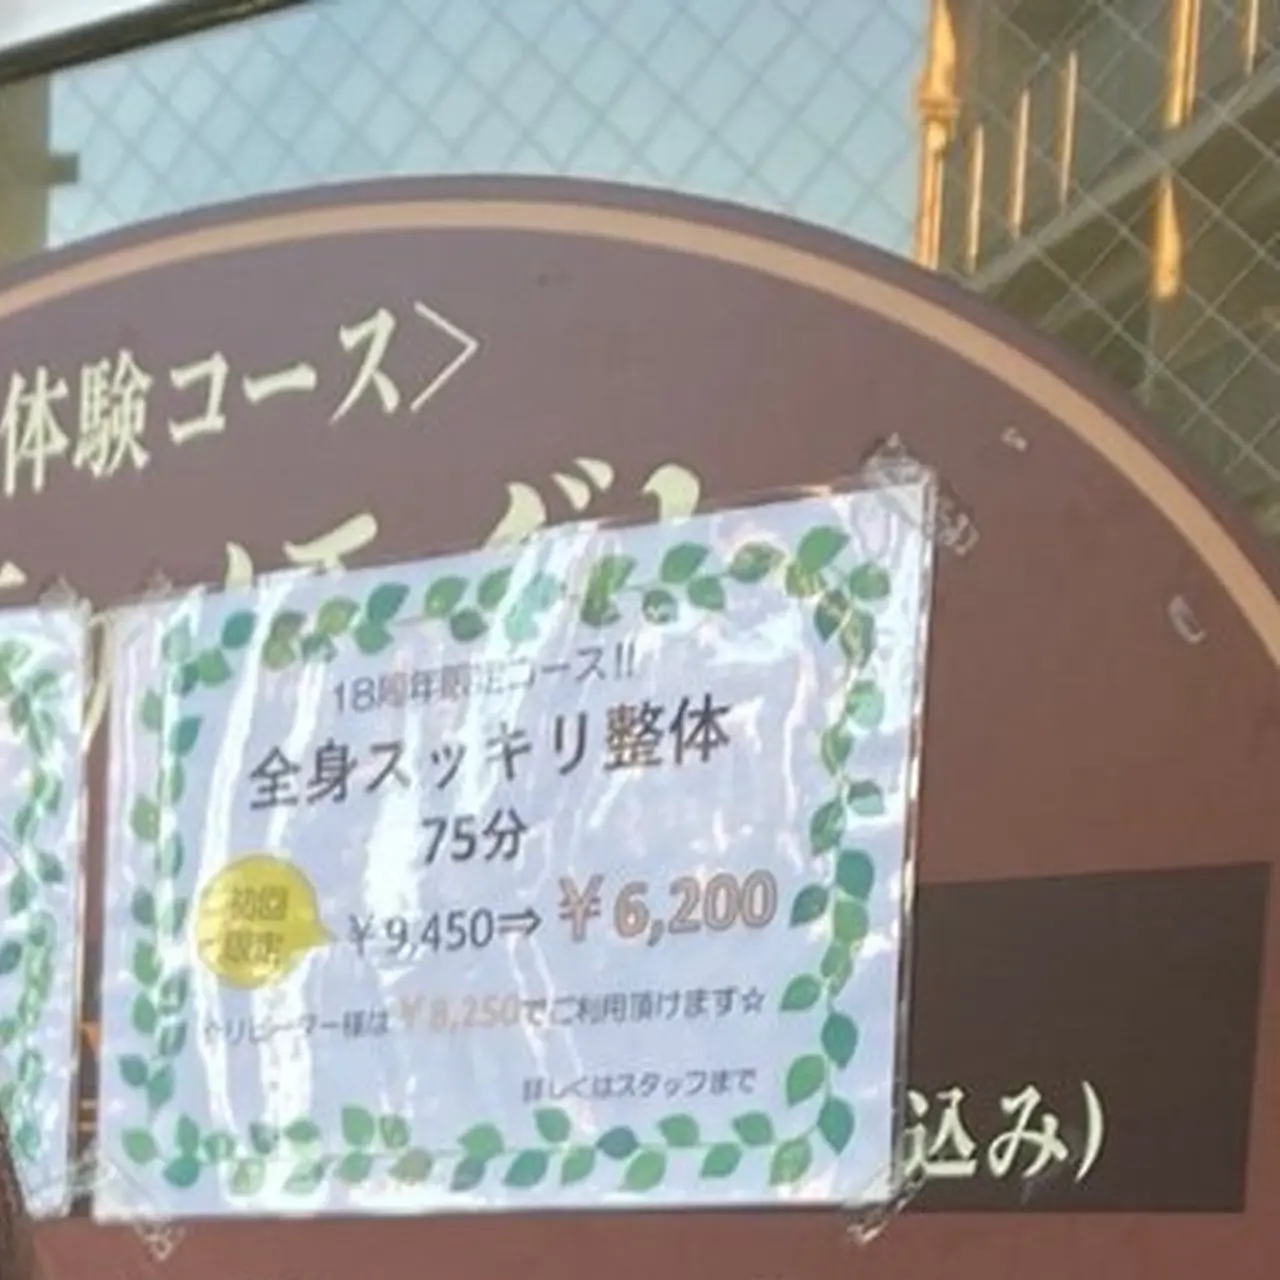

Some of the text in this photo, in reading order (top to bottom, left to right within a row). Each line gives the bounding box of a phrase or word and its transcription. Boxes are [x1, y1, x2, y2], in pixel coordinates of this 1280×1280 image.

[249, 692, 731, 812] 全身スッキリ整体
[420, 805, 529, 866] 75分
[556, 868, 779, 948] ¥6,200
